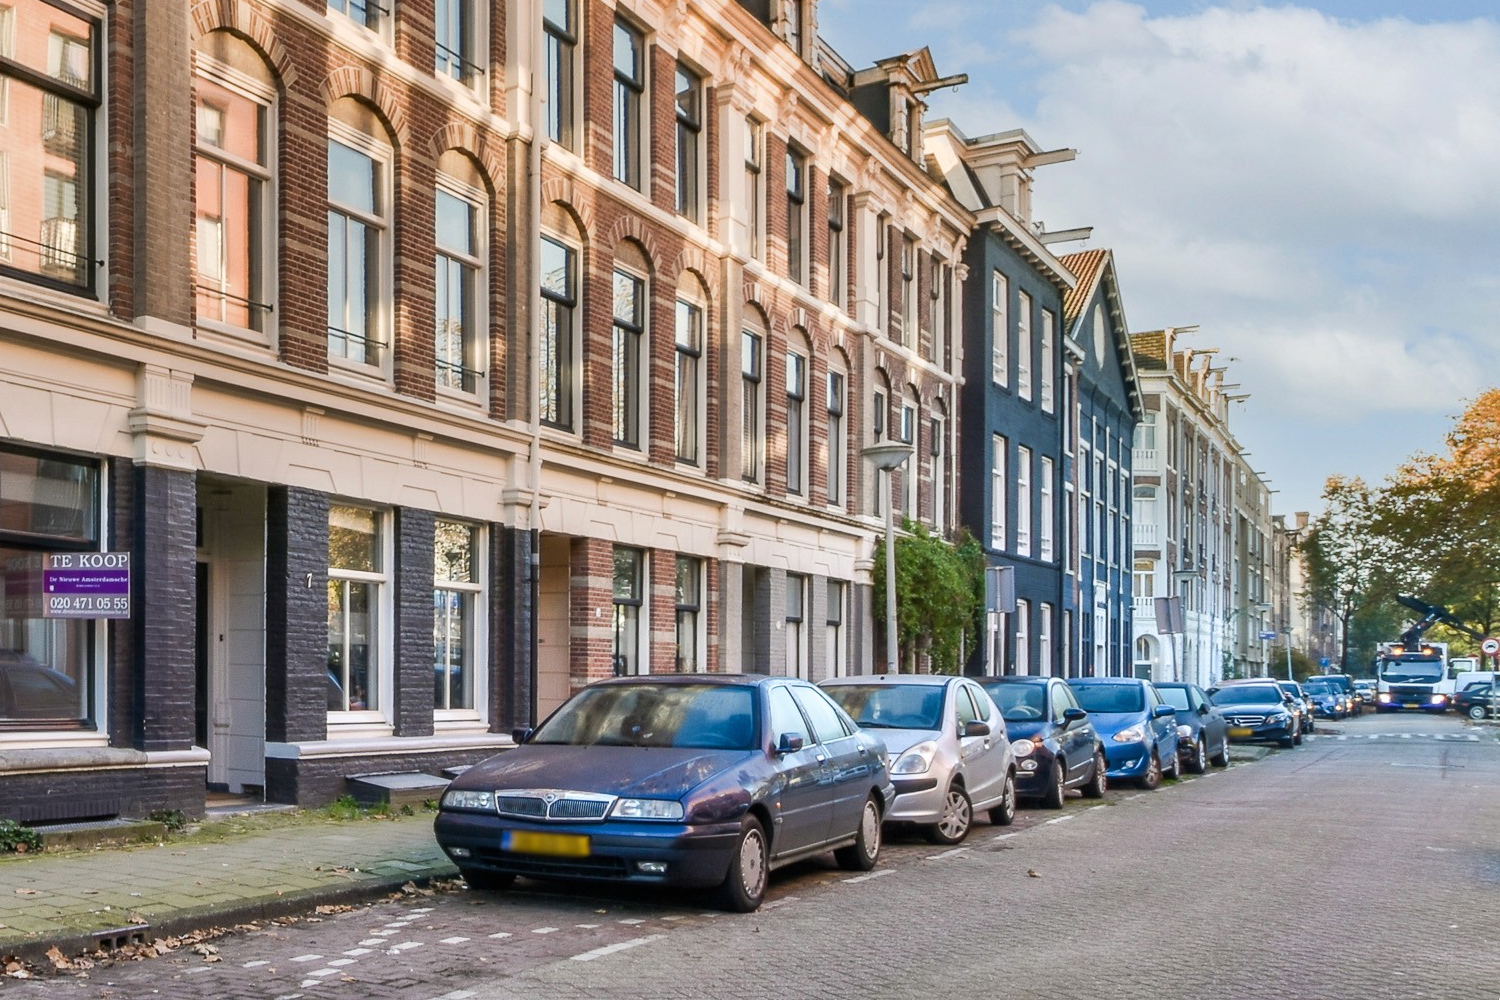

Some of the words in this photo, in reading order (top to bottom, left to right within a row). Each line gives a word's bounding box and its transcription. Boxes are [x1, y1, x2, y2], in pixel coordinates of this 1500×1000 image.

[50, 554, 72, 567] TE
[79, 554, 128, 567] KOOP
[50, 597, 71, 609] 020
[73, 597, 93, 609] 471
[96, 597, 111, 610] 05
[113, 597, 128, 610] 55
